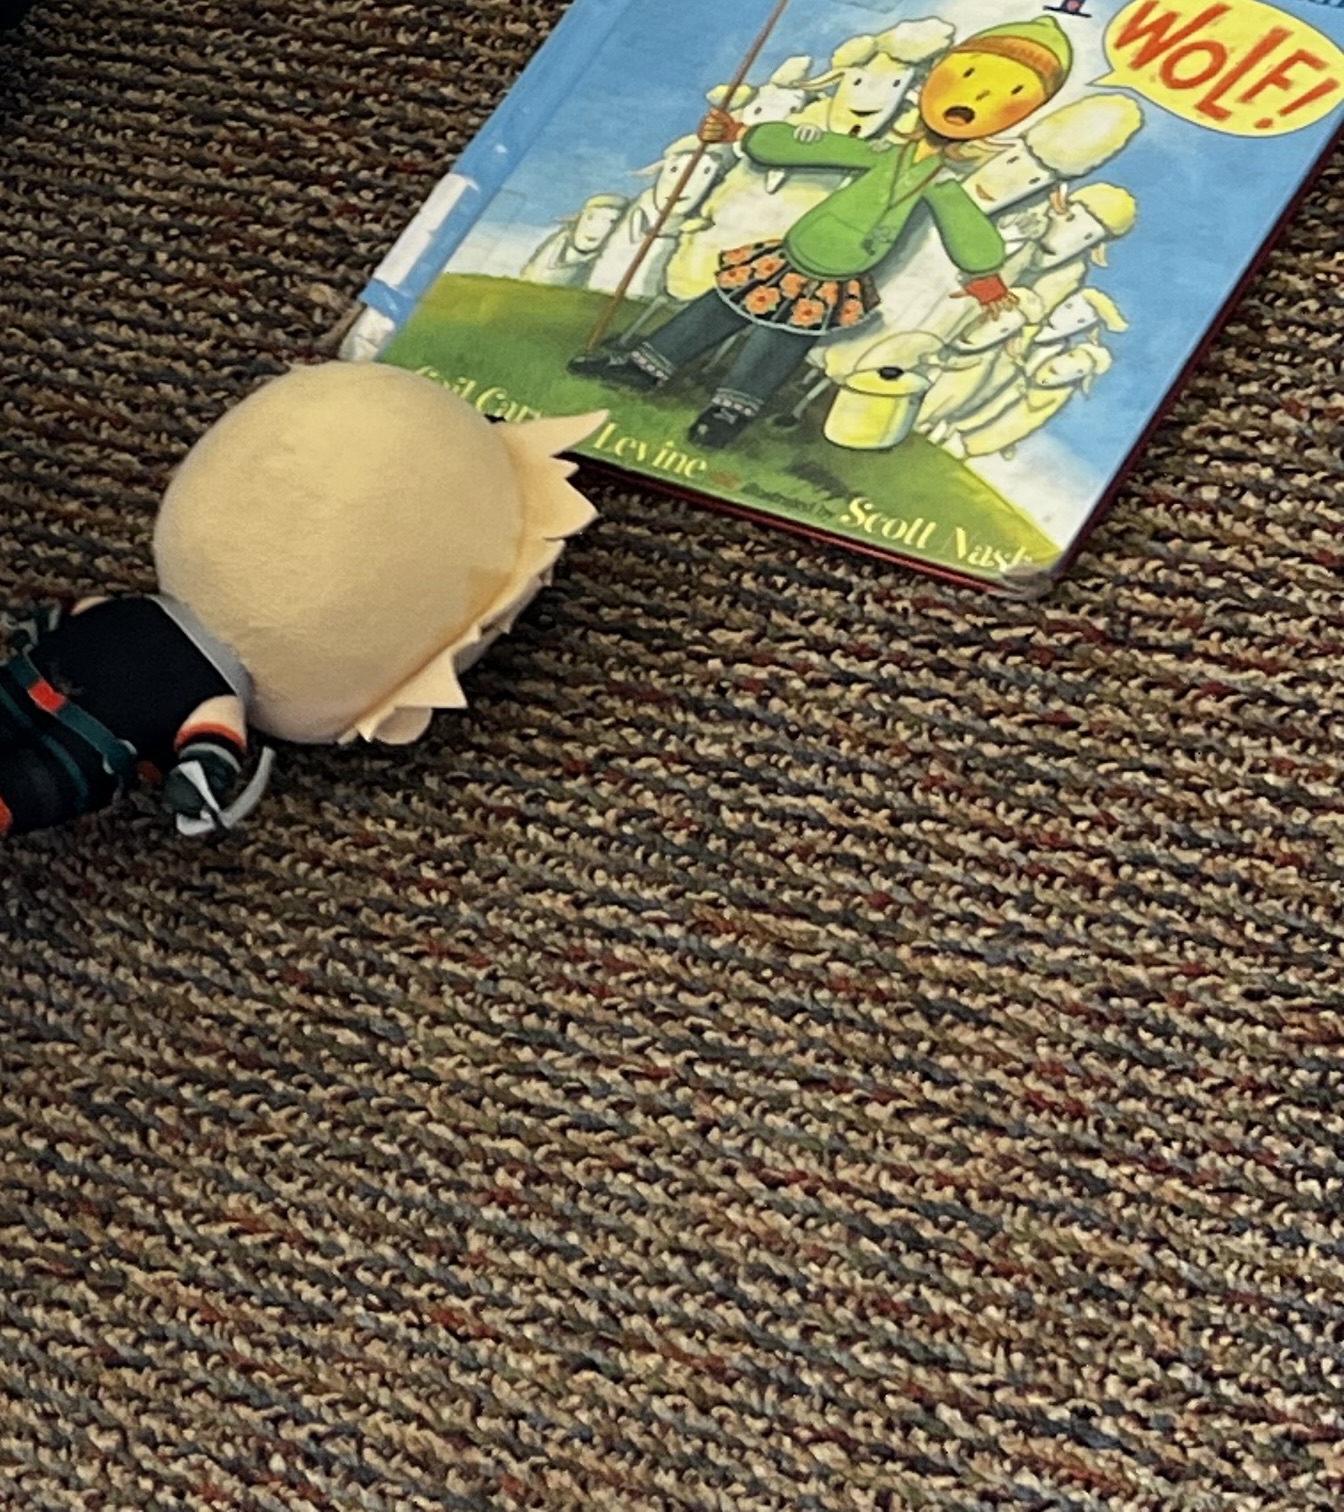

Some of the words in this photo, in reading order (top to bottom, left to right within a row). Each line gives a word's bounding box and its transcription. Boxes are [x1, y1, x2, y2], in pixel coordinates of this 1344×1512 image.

[1113, 0, 1341, 130] WOLF!
[593, 421, 708, 479] Levine
[839, 496, 938, 550] Scott
